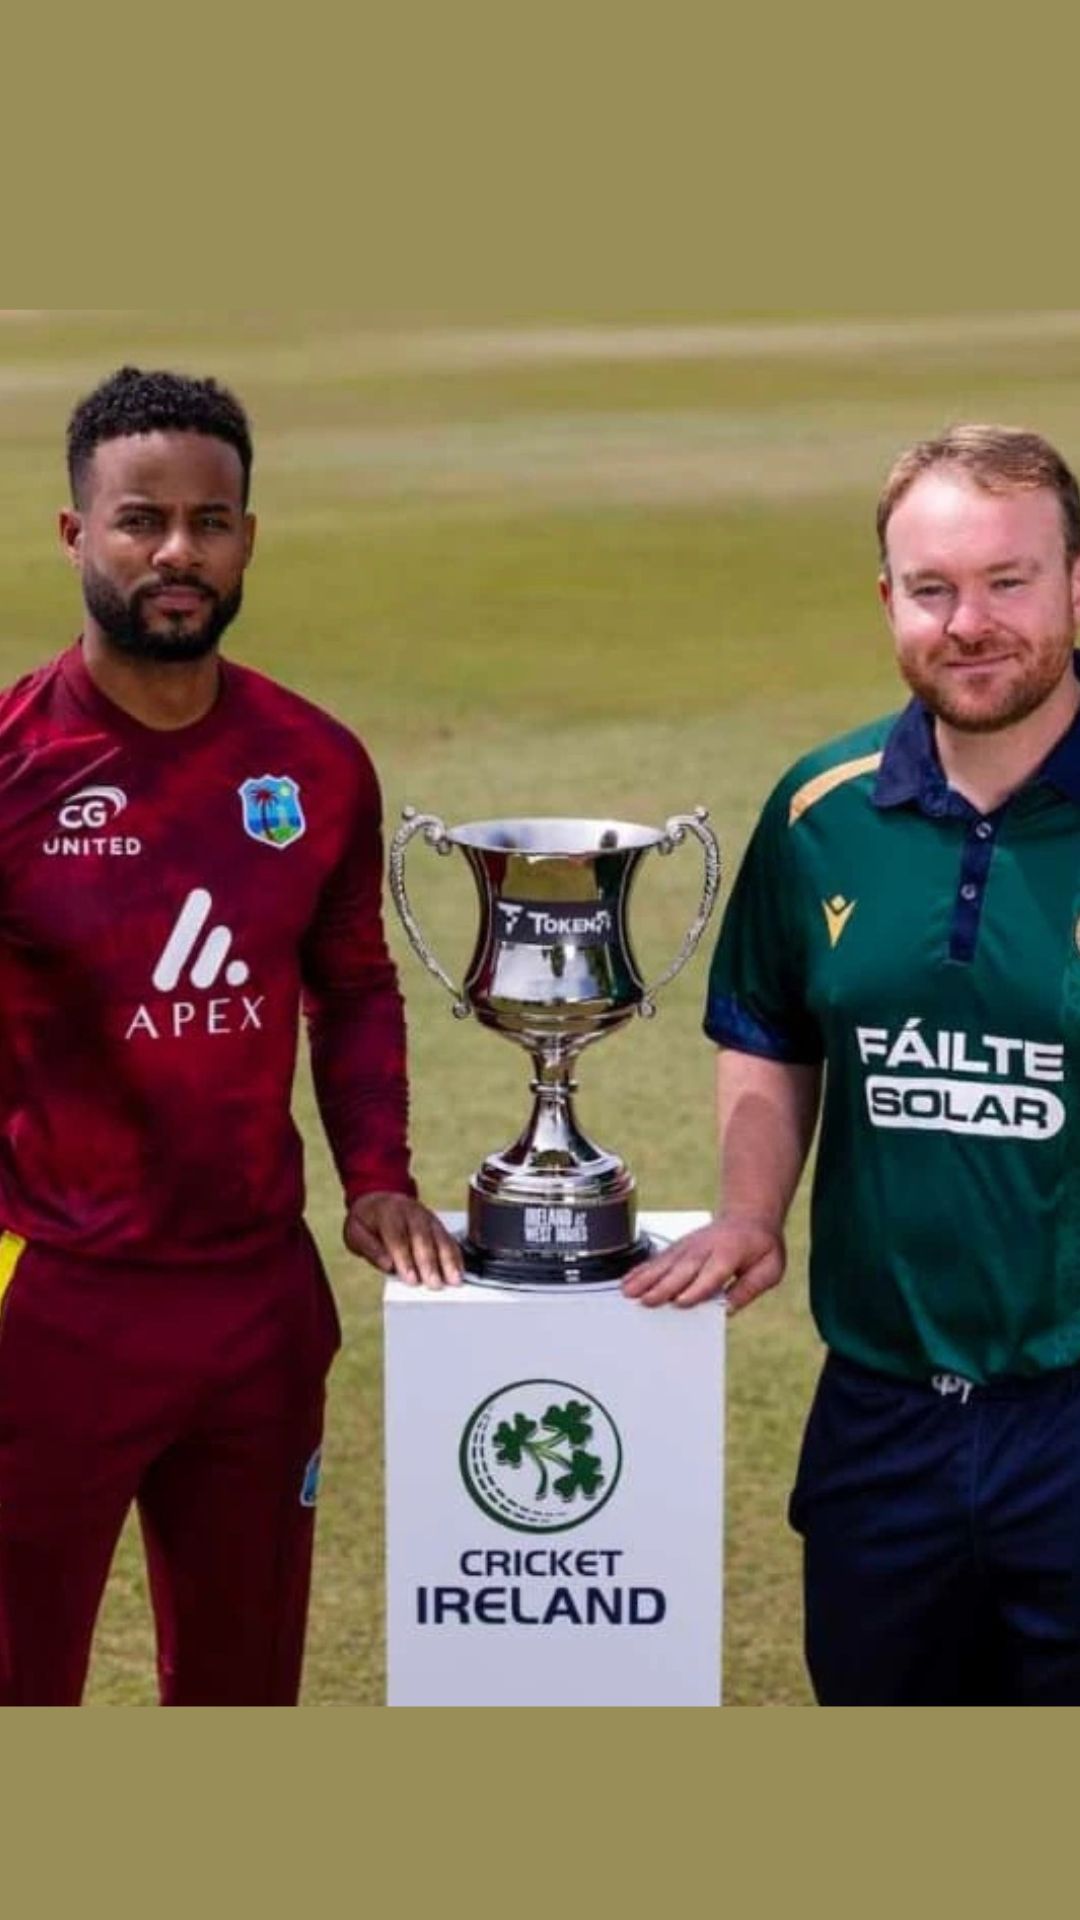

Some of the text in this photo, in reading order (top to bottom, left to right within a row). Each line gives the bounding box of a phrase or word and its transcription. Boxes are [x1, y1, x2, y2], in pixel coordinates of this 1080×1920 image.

[59, 802, 108, 829] CG
[43, 837, 142, 855] UNITED
[126, 996, 264, 1039] APEX
[856, 1017, 1065, 1082] FÁILTE
[870, 1086, 1048, 1129] SOLAR
[459, 1549, 623, 1577] CRICKET
[417, 1586, 667, 1625] IRELAND
